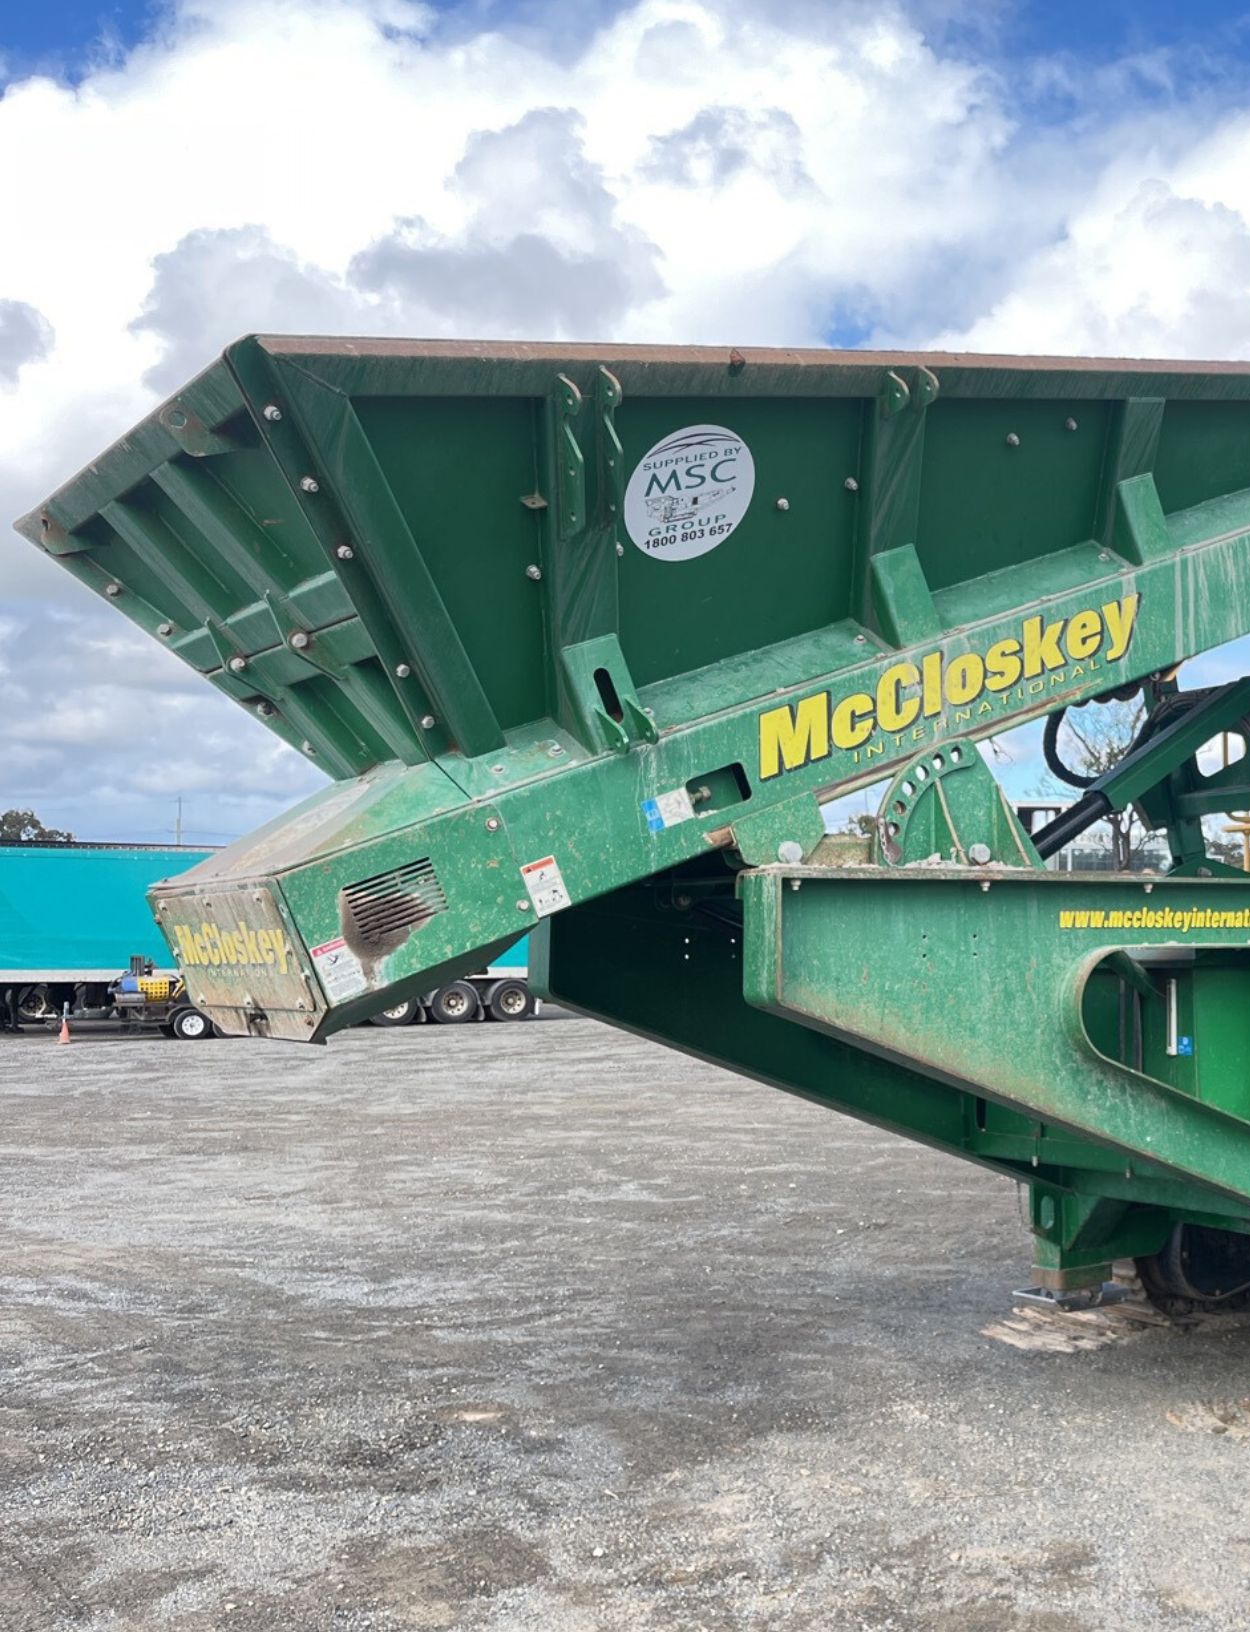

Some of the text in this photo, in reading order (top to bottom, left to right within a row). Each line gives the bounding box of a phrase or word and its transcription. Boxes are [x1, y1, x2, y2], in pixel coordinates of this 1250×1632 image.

[642, 446, 742, 471] SUPPLIED BY
[644, 458, 737, 498] MSC
[643, 523, 734, 550] 1800 803 657
[648, 514, 727, 538] GROUP
[758, 591, 1141, 780] McCloskey
[852, 659, 1100, 763] INTERNATIONAL
[173, 921, 288, 975] McCloskey
